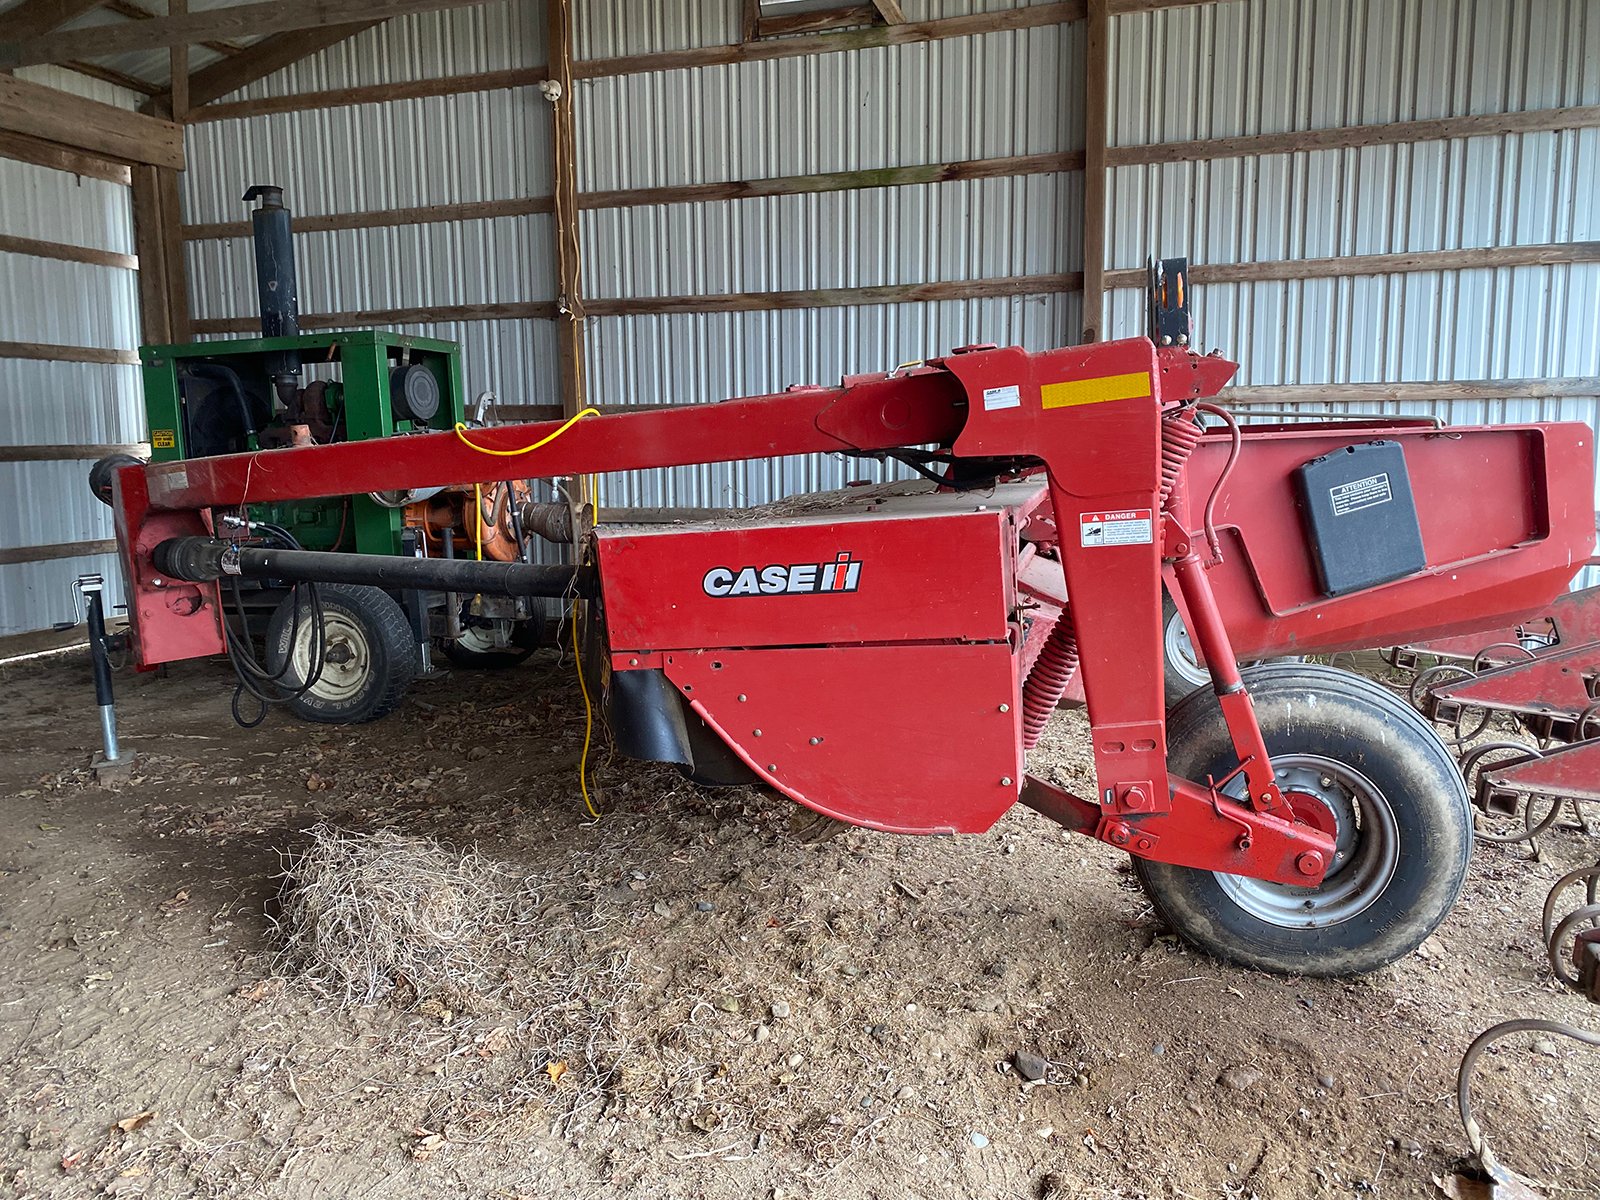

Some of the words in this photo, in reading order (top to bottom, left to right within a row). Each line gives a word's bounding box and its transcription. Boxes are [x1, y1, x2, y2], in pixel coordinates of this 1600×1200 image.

[1342, 478, 1378, 494] ATTENTION
[1104, 512, 1136, 520] DANGER
[702, 564, 818, 597] CASE
